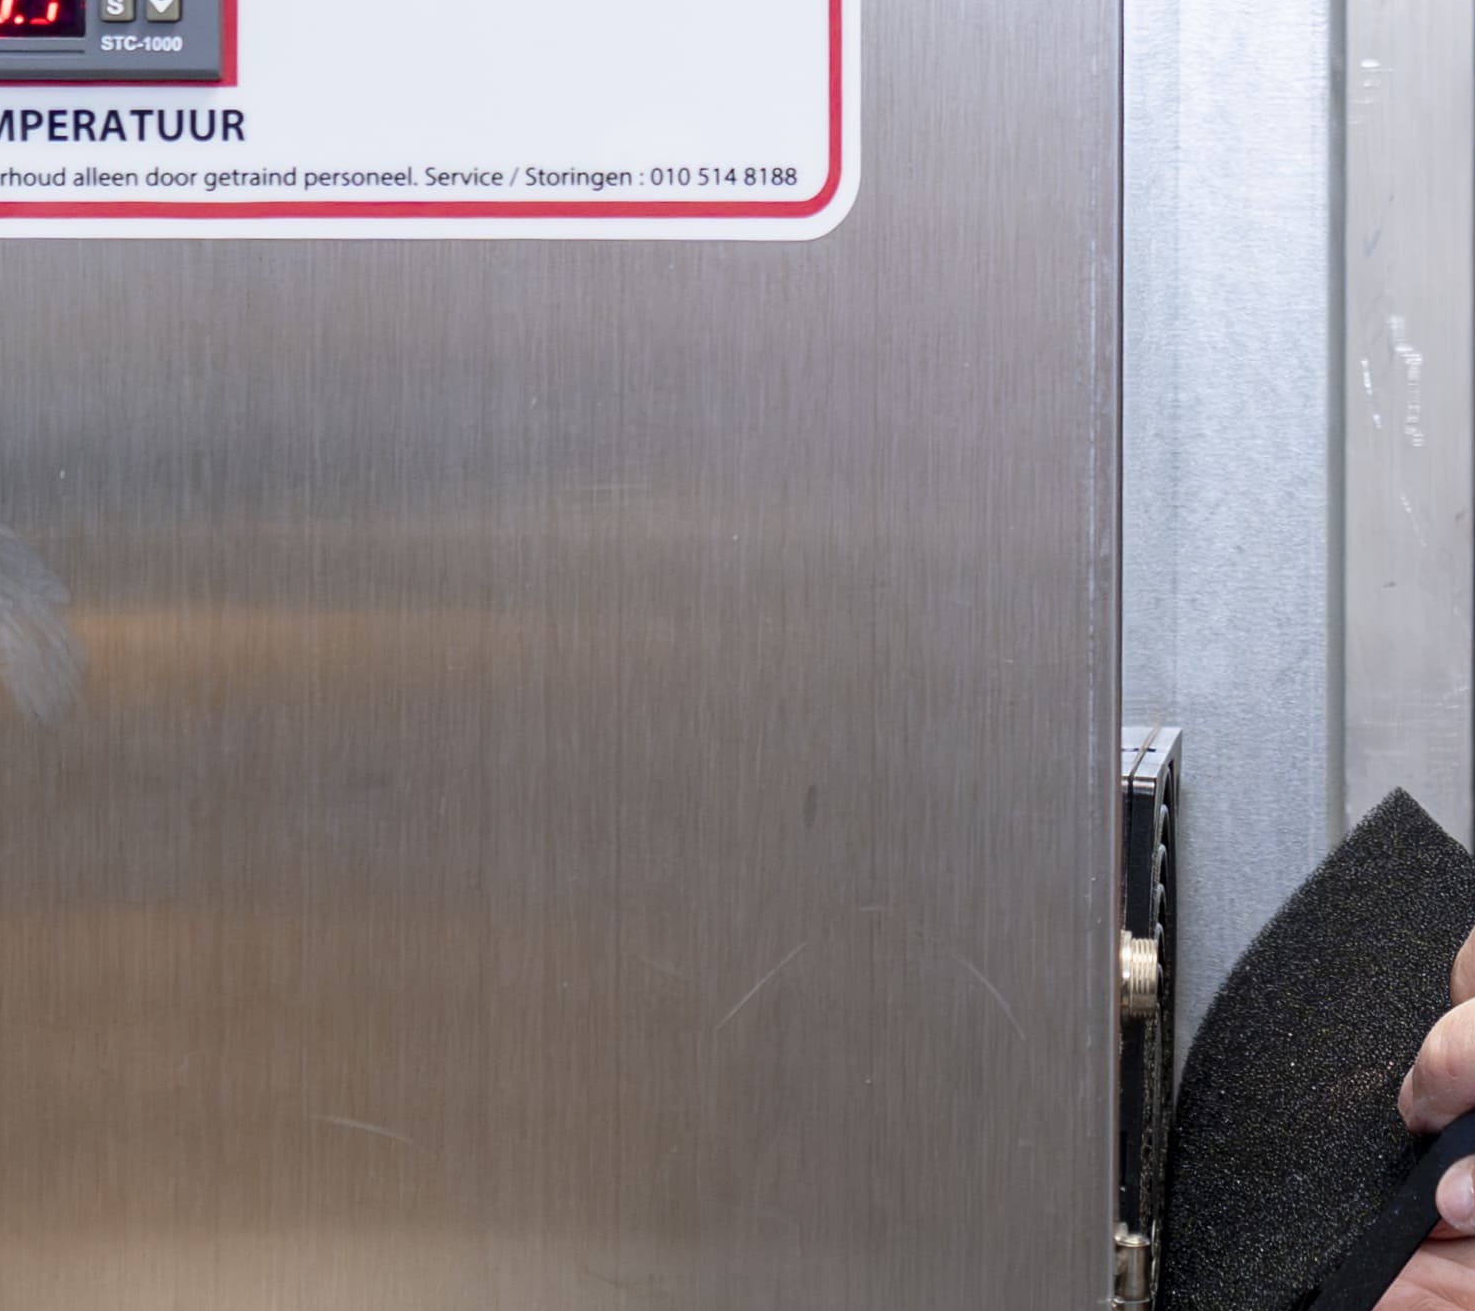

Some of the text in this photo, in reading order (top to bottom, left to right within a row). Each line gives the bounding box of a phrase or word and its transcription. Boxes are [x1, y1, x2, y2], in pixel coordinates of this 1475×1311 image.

[100, 35, 183, 52] STC-1000
[73, 167, 138, 187] alleen
[145, 167, 198, 187] door
[203, 167, 297, 192] getraind
[304, 166, 418, 191] personeel.
[424, 166, 504, 187] Service
[525, 166, 632, 192] Storingen
[650, 167, 691, 187] 010
[698, 167, 737, 186] 514
[743, 167, 798, 187] 8188
